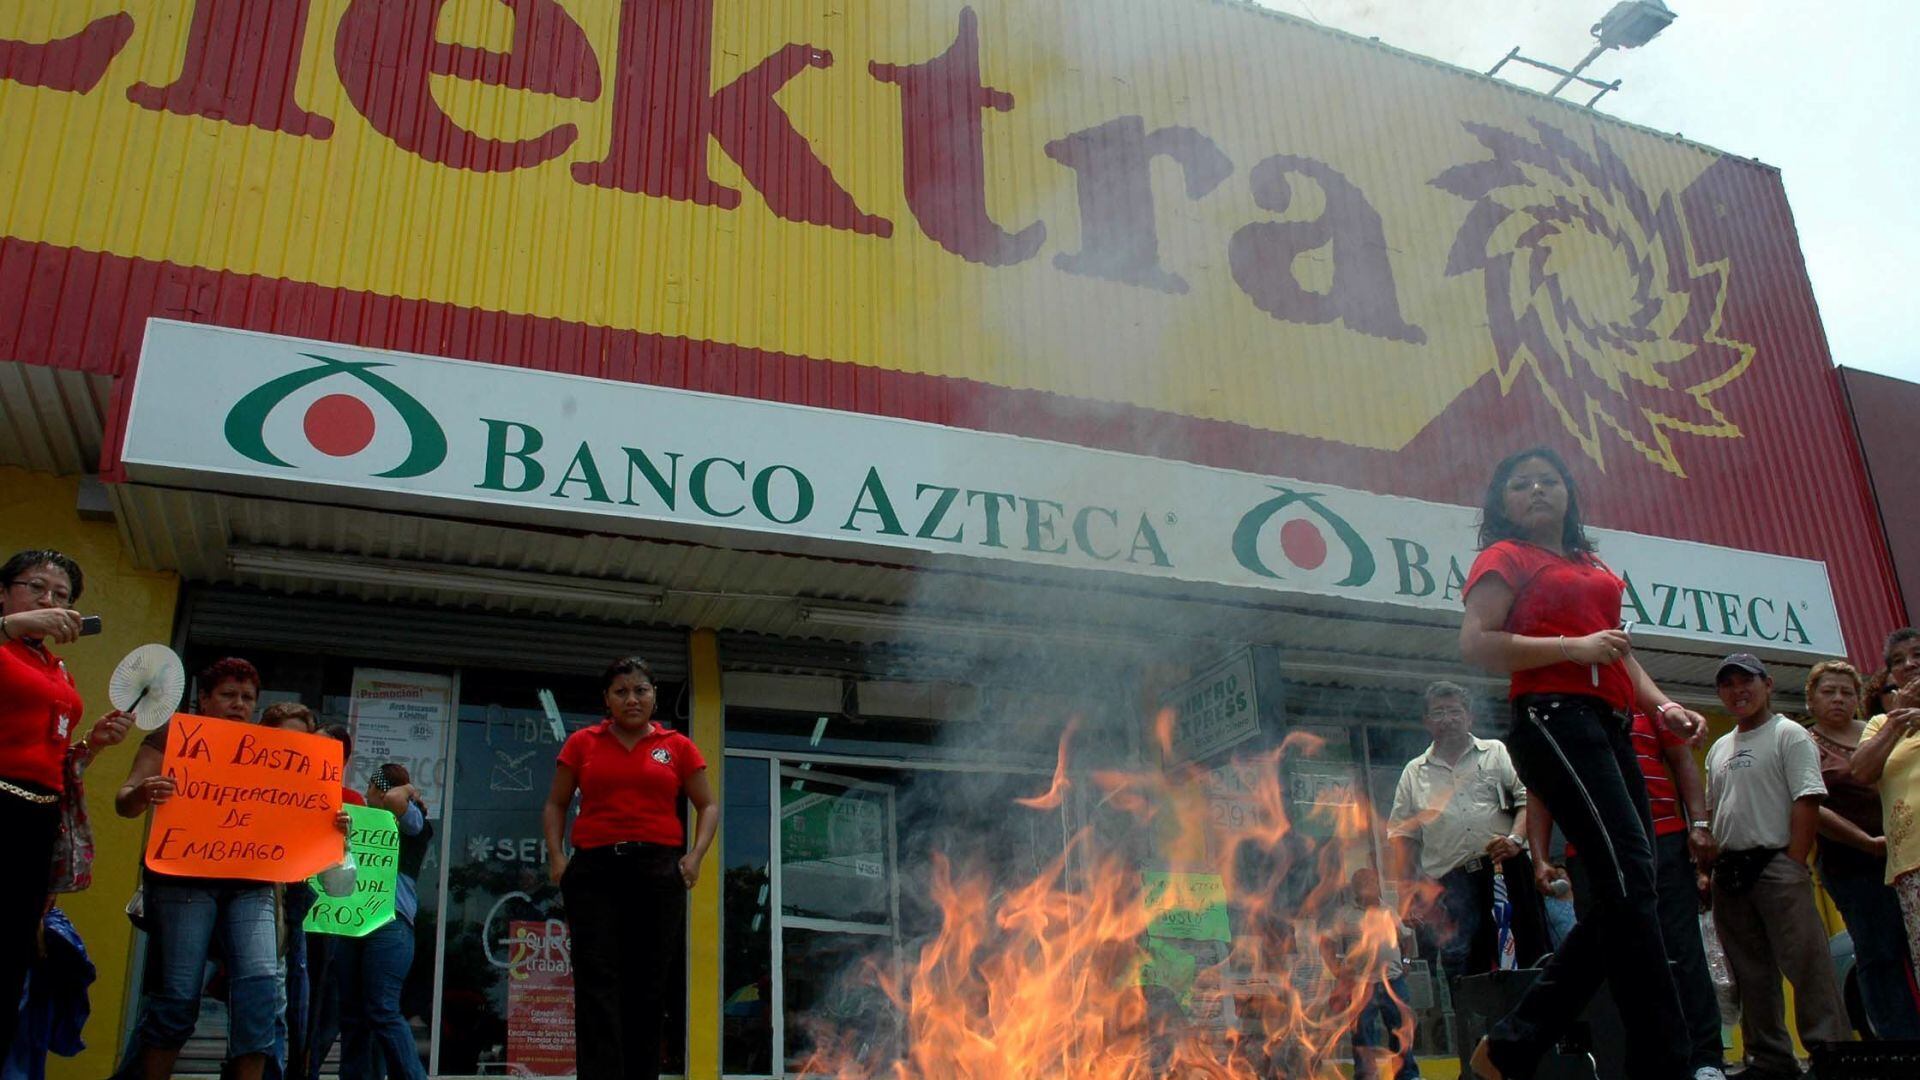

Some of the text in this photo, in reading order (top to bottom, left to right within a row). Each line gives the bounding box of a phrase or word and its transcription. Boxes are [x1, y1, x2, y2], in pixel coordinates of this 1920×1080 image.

[0, 0, 1427, 346] lektra
[474, 418, 815, 525] BANCO
[178, 721, 341, 783] YA BASTA DE
[166, 766, 331, 812] NOTIFICACIONES
[218, 808, 253, 829] DE
[153, 827, 286, 863] EMBARGO
[350, 829, 399, 847] ZTECA
[351, 851, 394, 868] TICA
[526, 956, 574, 977] trabaj
